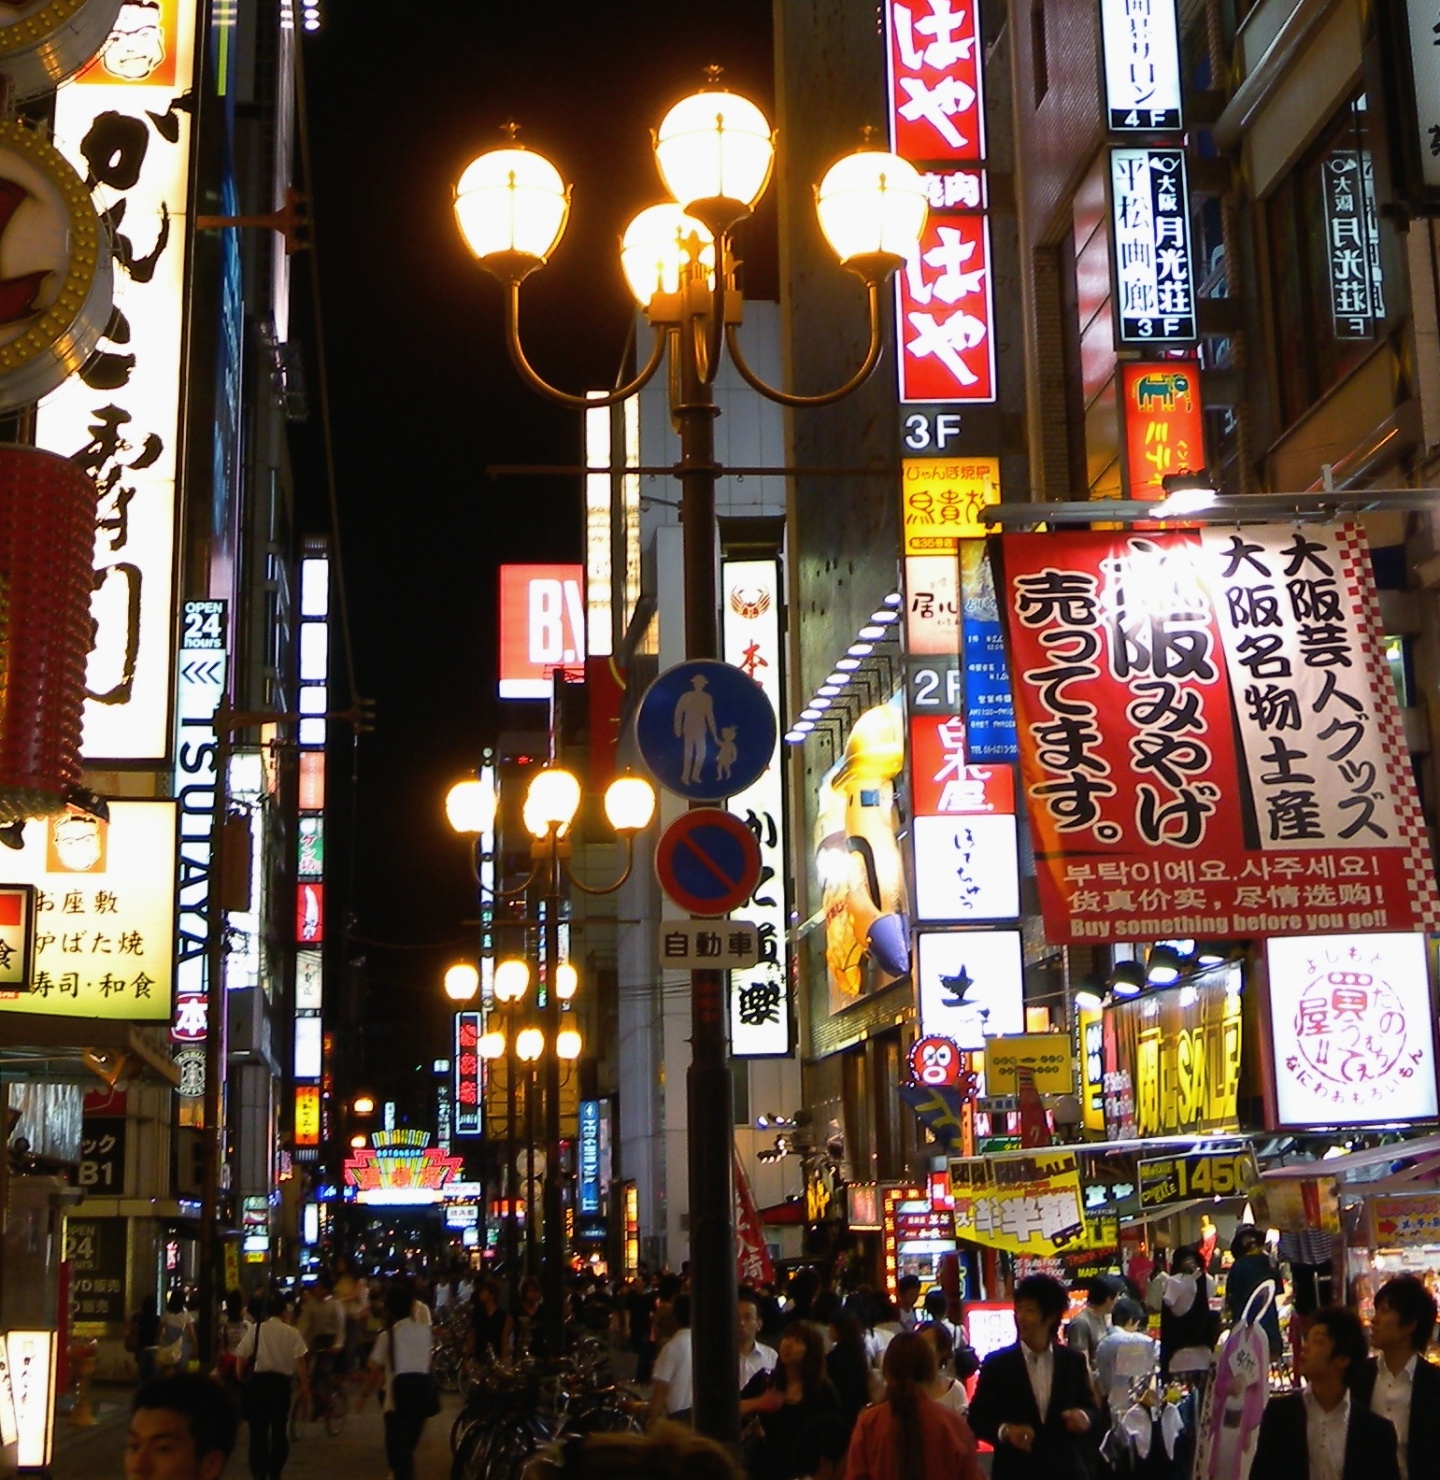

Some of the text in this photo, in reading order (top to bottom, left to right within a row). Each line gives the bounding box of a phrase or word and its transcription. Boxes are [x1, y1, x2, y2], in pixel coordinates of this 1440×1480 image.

[1115, 157, 1153, 313] 平松画廊
[1155, 174, 1190, 313] 大阪 月光荘
[903, 226, 987, 387] はや
[904, 414, 961, 450] 3F
[185, 602, 223, 614] OPEN
[185, 614, 221, 638] 24
[184, 637, 222, 648] hours
[1104, 538, 1218, 847] 阪みやげ
[1219, 536, 1325, 841] 大阪名物土産
[1280, 534, 1388, 840] 大阪芸人グッズ
[1016, 570, 1123, 843] 売ってます。
[36, 888, 119, 915] お座敷
[1070, 909, 1388, 938] Buy something before you go!!
[34, 929, 144, 956] 炉ばた焼
[664, 930, 754, 958] 自動車
[1306, 946, 1383, 975] よしもと
[176, 998, 209, 1036] 本
[79, 1159, 114, 1188] B1
